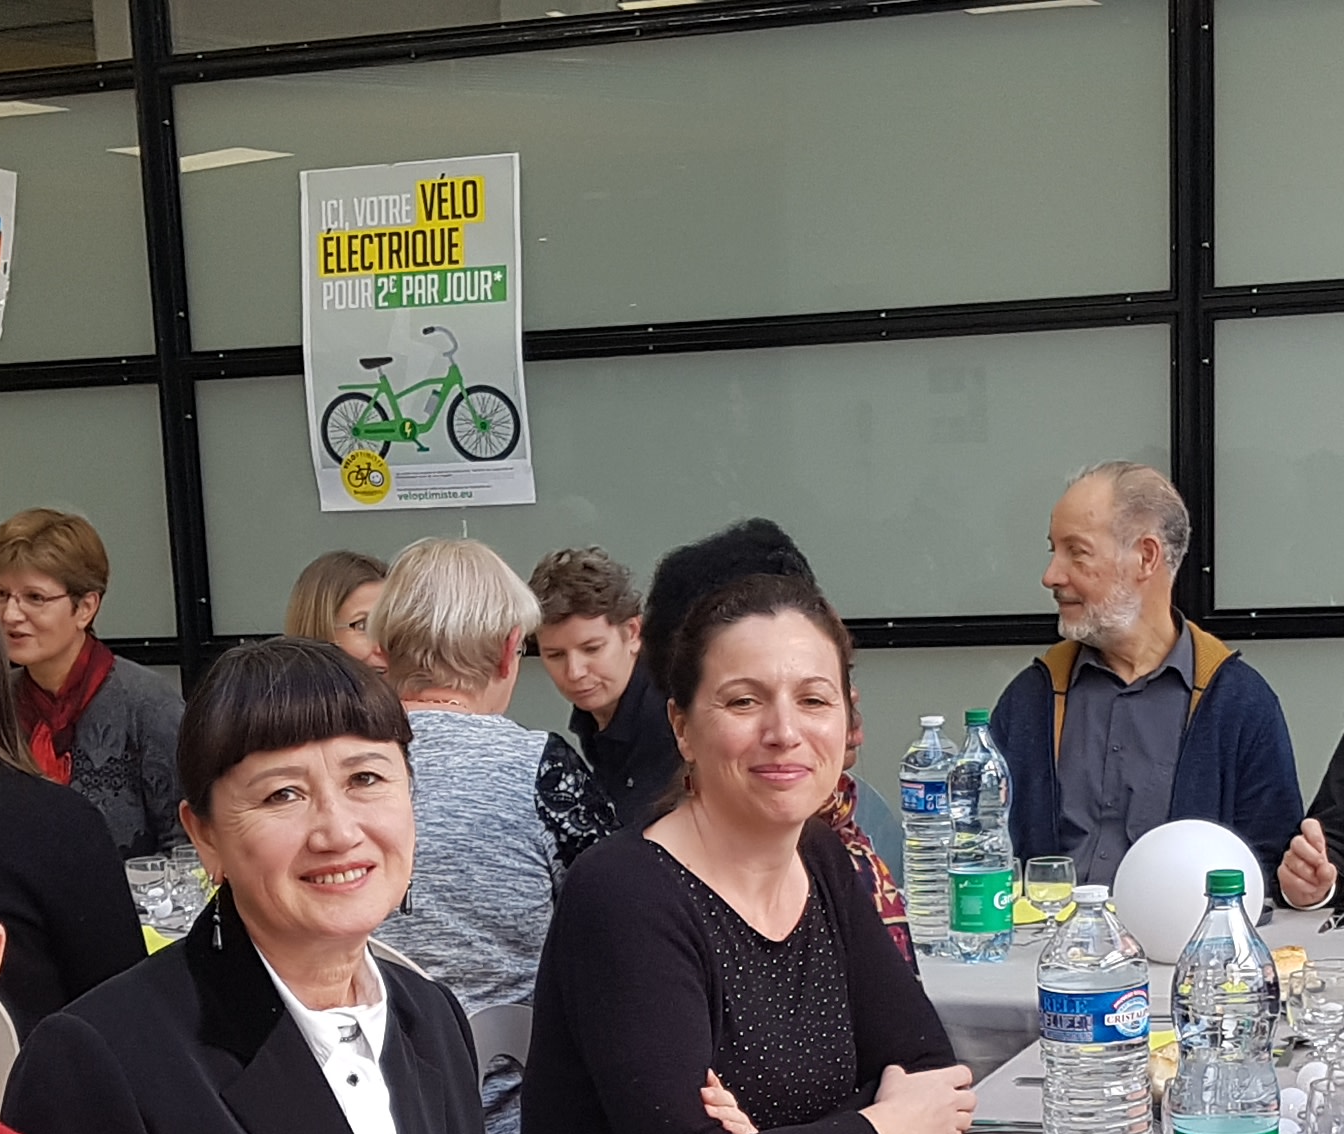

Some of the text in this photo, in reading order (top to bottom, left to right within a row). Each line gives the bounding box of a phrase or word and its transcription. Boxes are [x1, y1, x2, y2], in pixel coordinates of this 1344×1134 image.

[321, 172, 479, 231] ICI, VOTRE VÉLO
[322, 227, 460, 275] ÉLECTRIQUE
[322, 277, 373, 310] POUR
[402, 273, 439, 306] PAR
[396, 489, 473, 502] veloptimiste.eu
